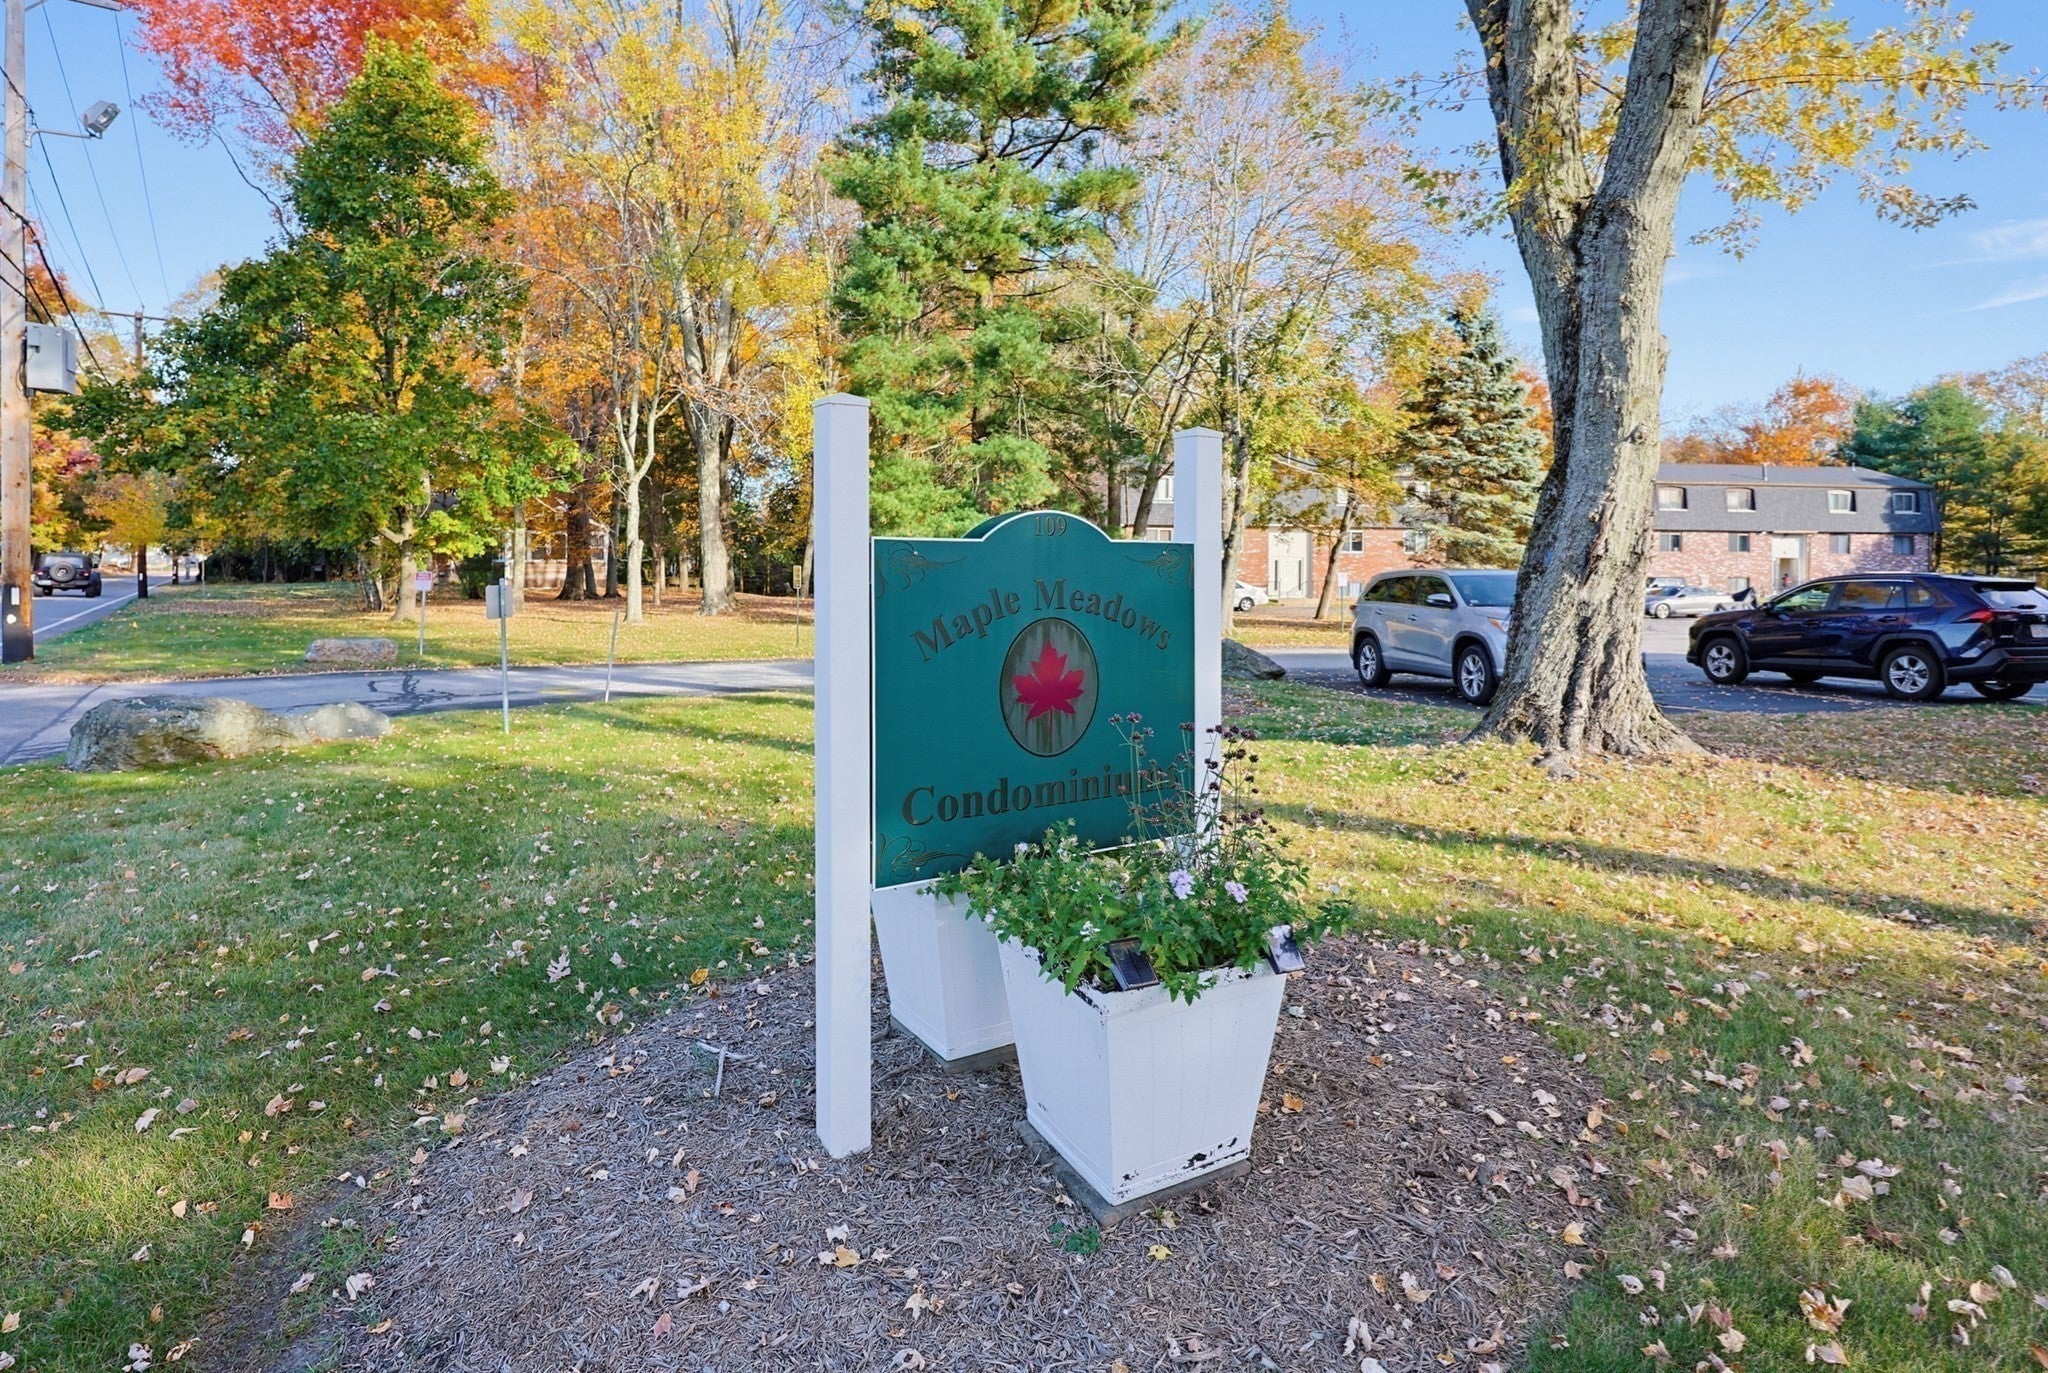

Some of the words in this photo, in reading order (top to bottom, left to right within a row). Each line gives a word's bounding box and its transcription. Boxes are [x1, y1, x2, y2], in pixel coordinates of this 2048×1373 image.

[1033, 515, 1068, 537] 109
[910, 587, 1020, 664] Maple
[1033, 578, 1172, 650] Meadows
